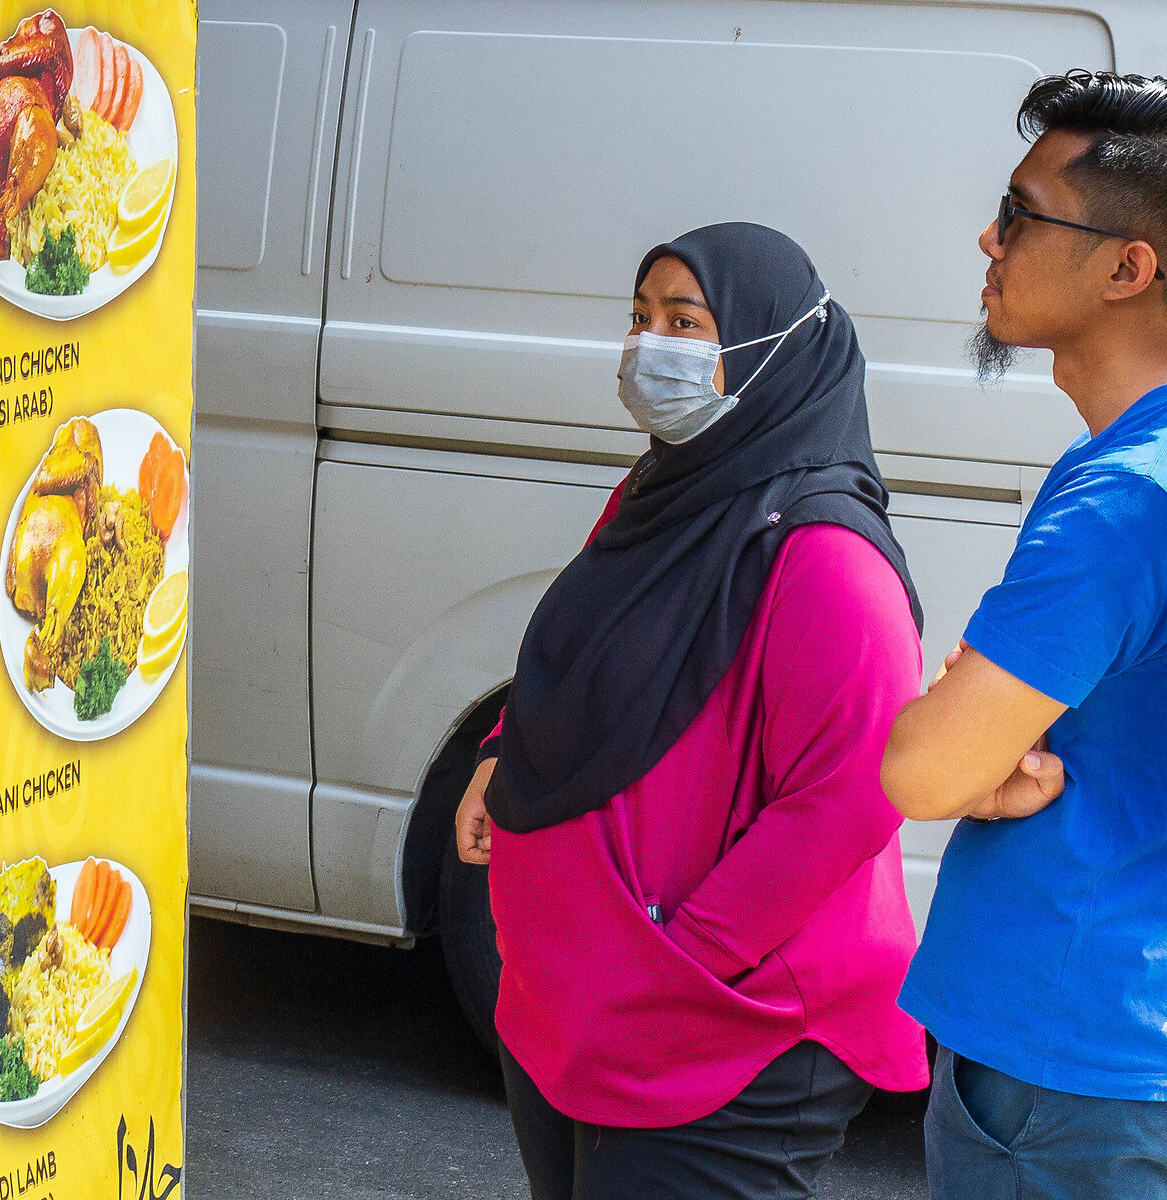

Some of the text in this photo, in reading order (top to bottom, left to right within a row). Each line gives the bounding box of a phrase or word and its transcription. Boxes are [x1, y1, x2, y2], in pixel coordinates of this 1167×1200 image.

[20, 341, 80, 378] CHICKEN
[13, 386, 54, 422] ARAB)
[22, 759, 81, 806] CHICKEN
[16, 1150, 57, 1194] LAMB
